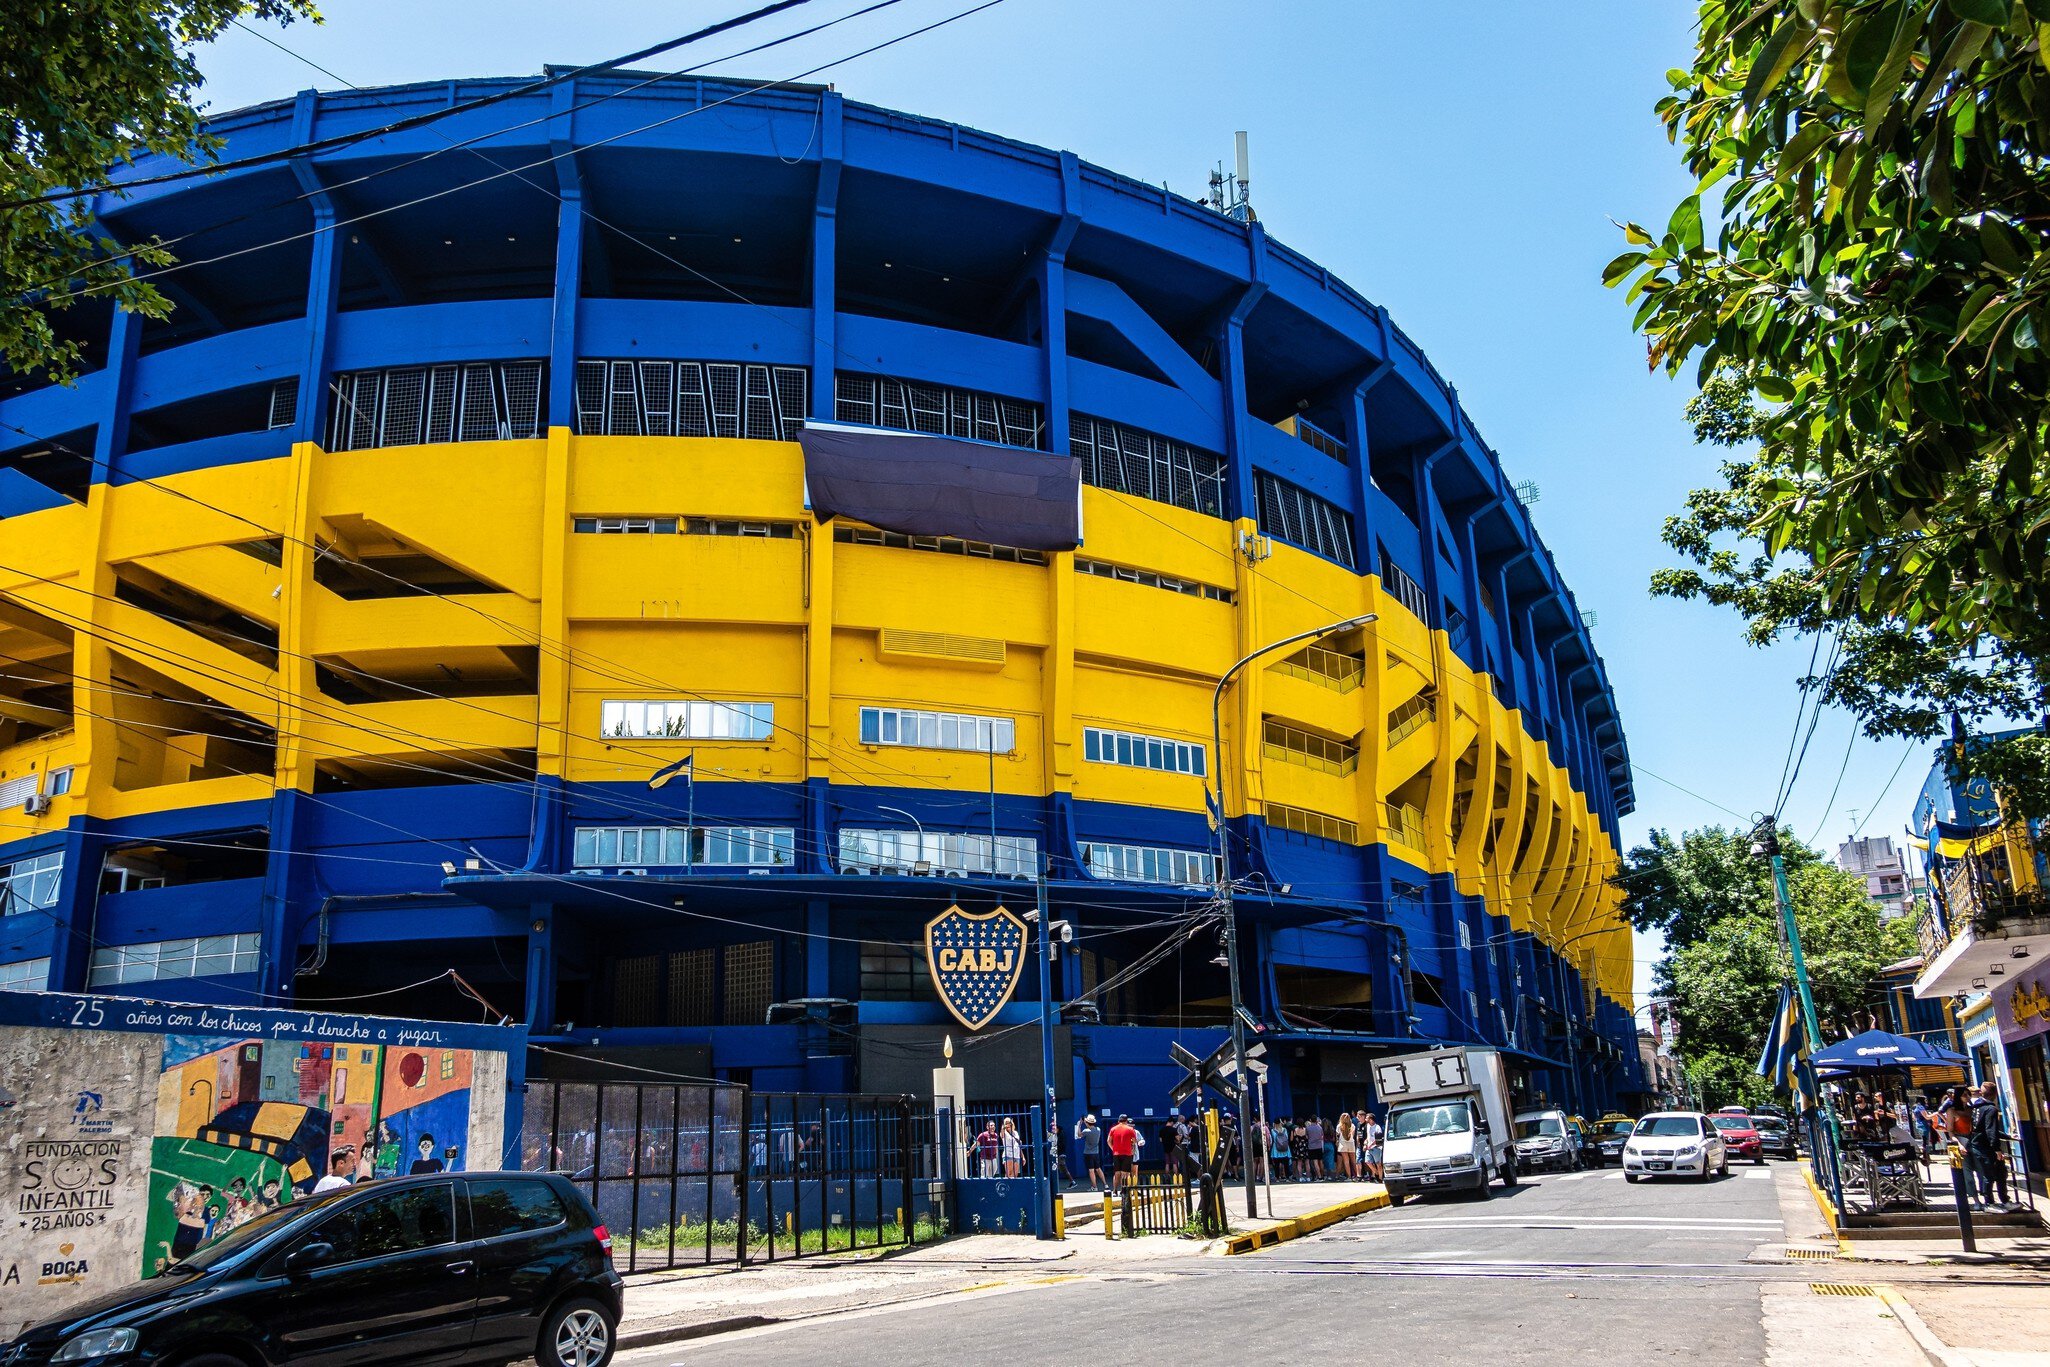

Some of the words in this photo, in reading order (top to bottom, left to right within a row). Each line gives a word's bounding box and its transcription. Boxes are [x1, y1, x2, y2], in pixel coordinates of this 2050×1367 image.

[939, 948, 1014, 972] CABJ
[71, 1000, 104, 1027] 25
[126, 1010, 162, 1025] años
[167, 1013, 193, 1026] con
[197, 1010, 218, 1029] los
[221, 1012, 262, 1032] chicos
[270, 1021, 297, 1039] por
[301, 1016, 315, 1034] el
[317, 1018, 370, 1039] derecho
[377, 1028, 387, 1039] a
[19, 1189, 114, 1211] INFANTIL
[31, 1216, 50, 1231] 25
[53, 1211, 95, 1229] AÑOS
[42, 1260, 88, 1277] BOCA
